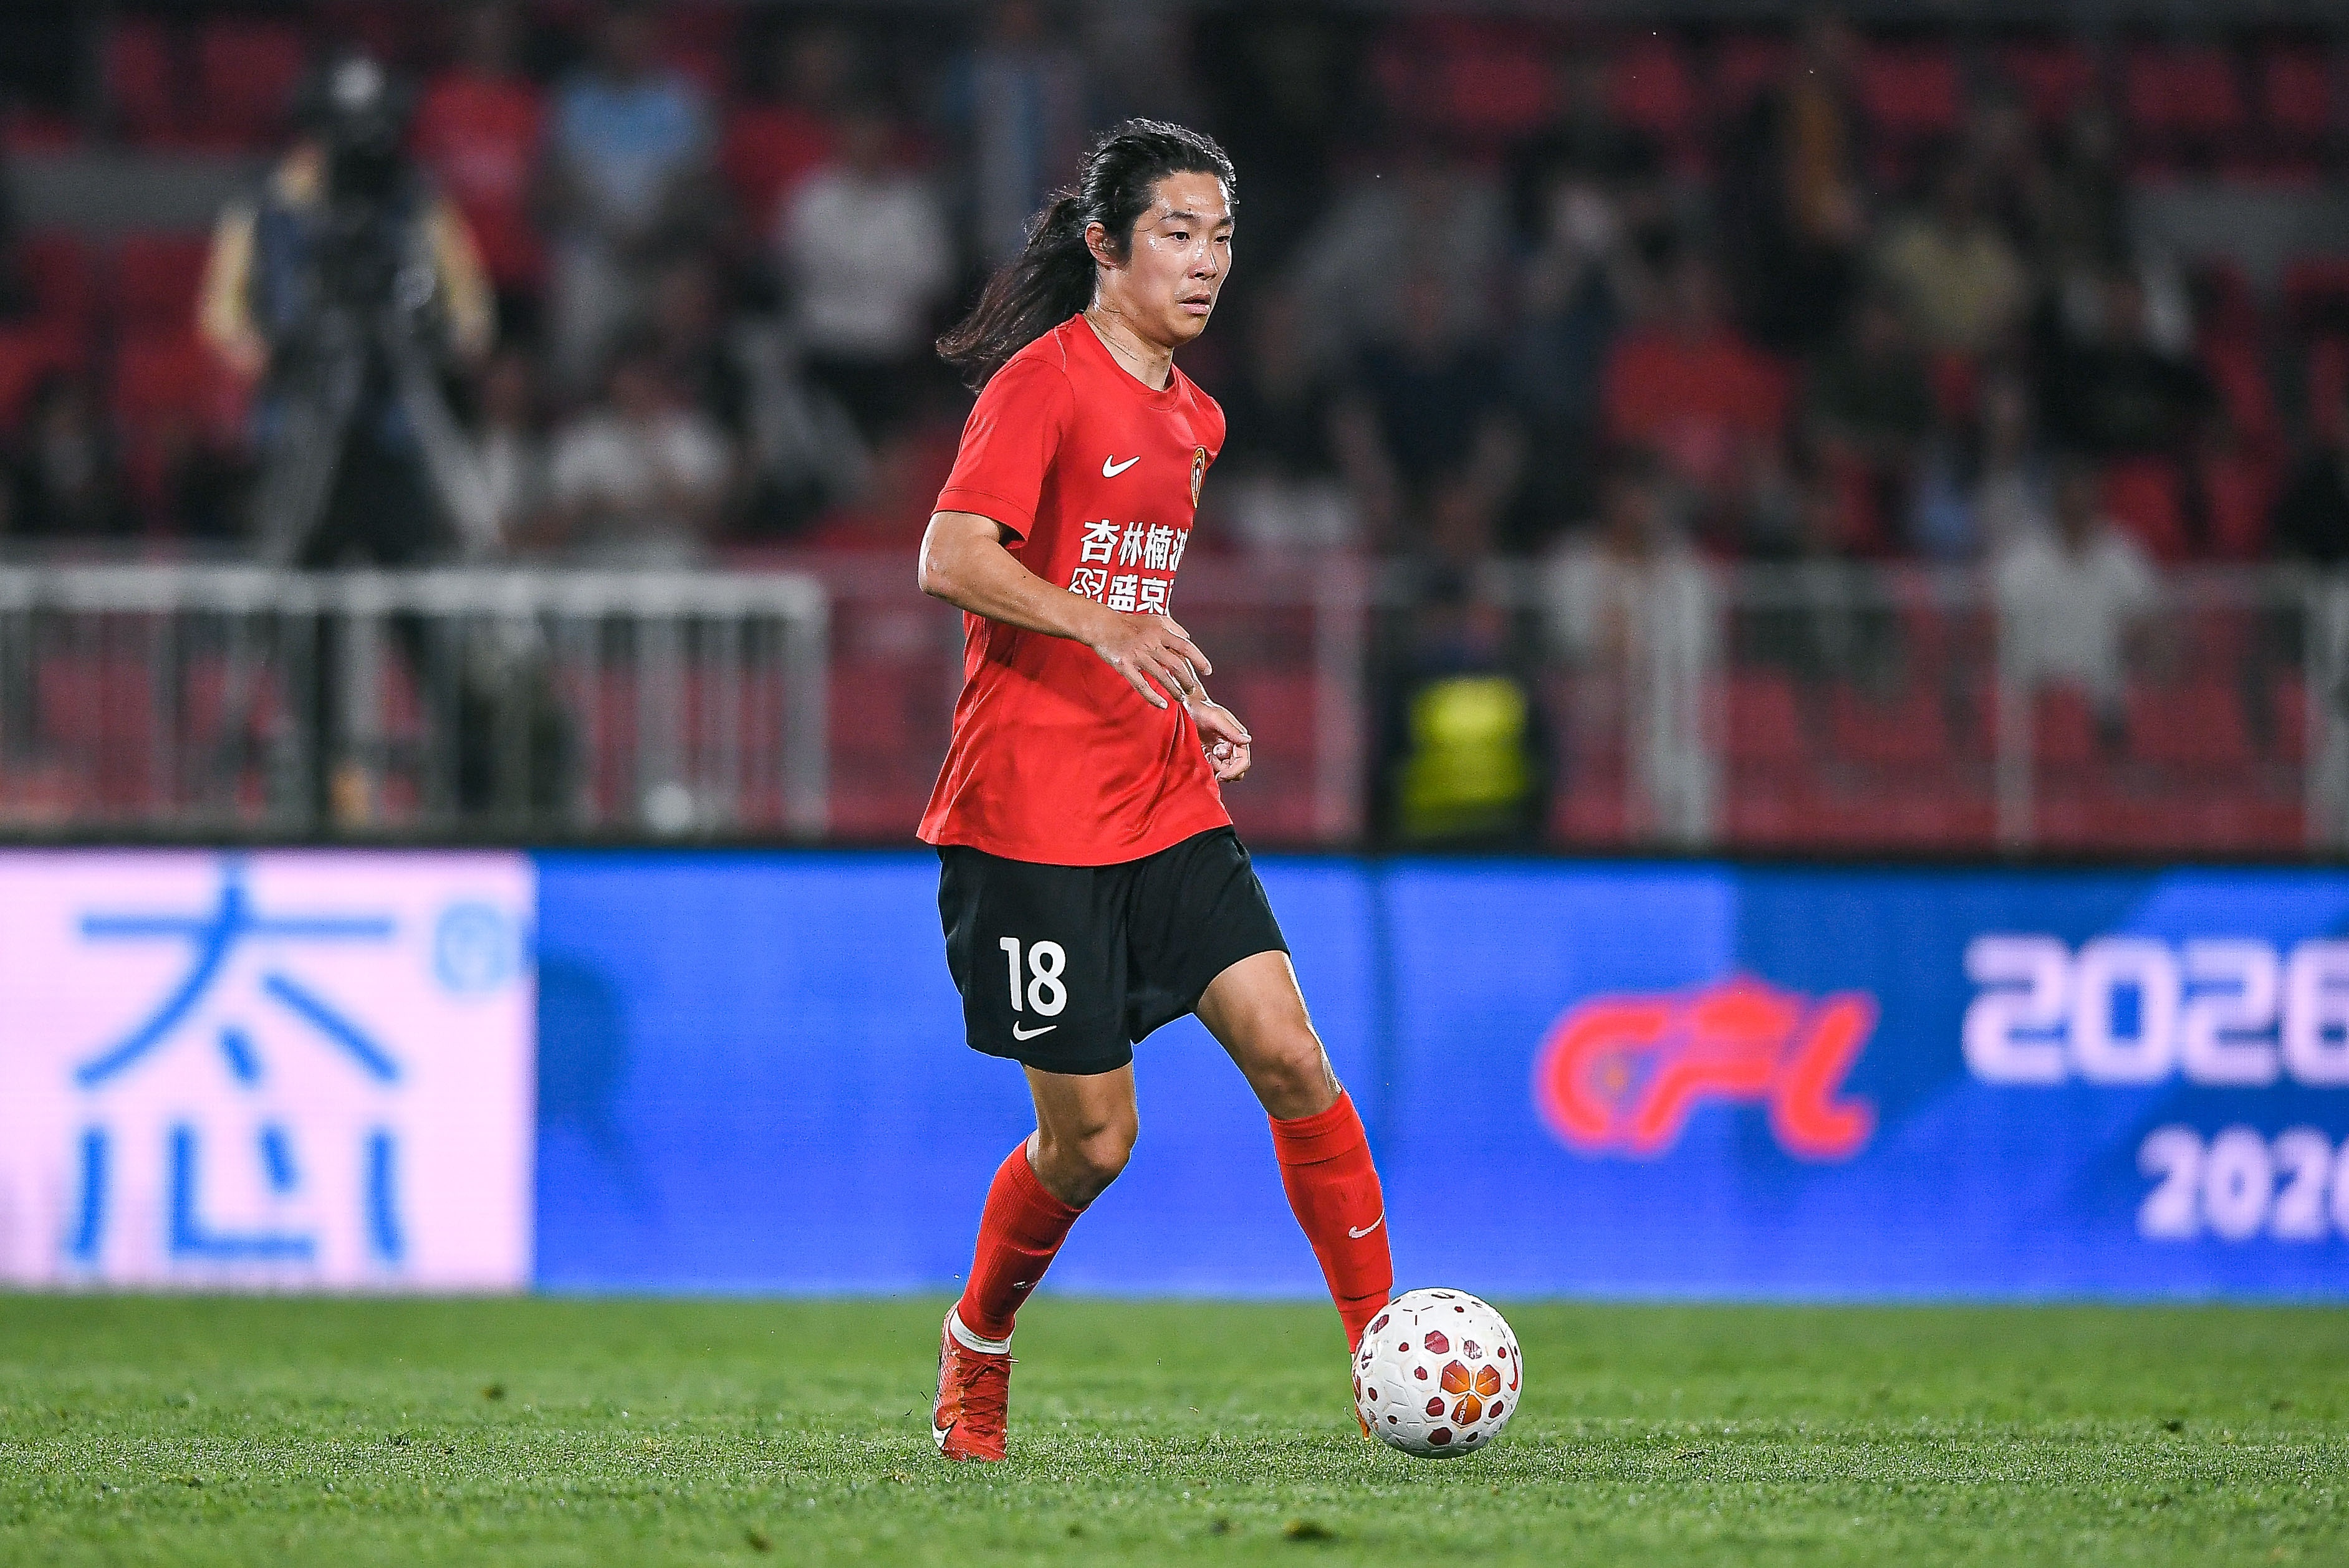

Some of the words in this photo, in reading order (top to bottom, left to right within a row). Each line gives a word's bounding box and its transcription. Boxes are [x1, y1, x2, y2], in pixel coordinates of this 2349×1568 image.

[1107, 574, 1174, 614] 盛京
[999, 937, 1067, 1016] 18
[69, 857, 404, 1268] 态
[2140, 1127, 2348, 1239] 202
